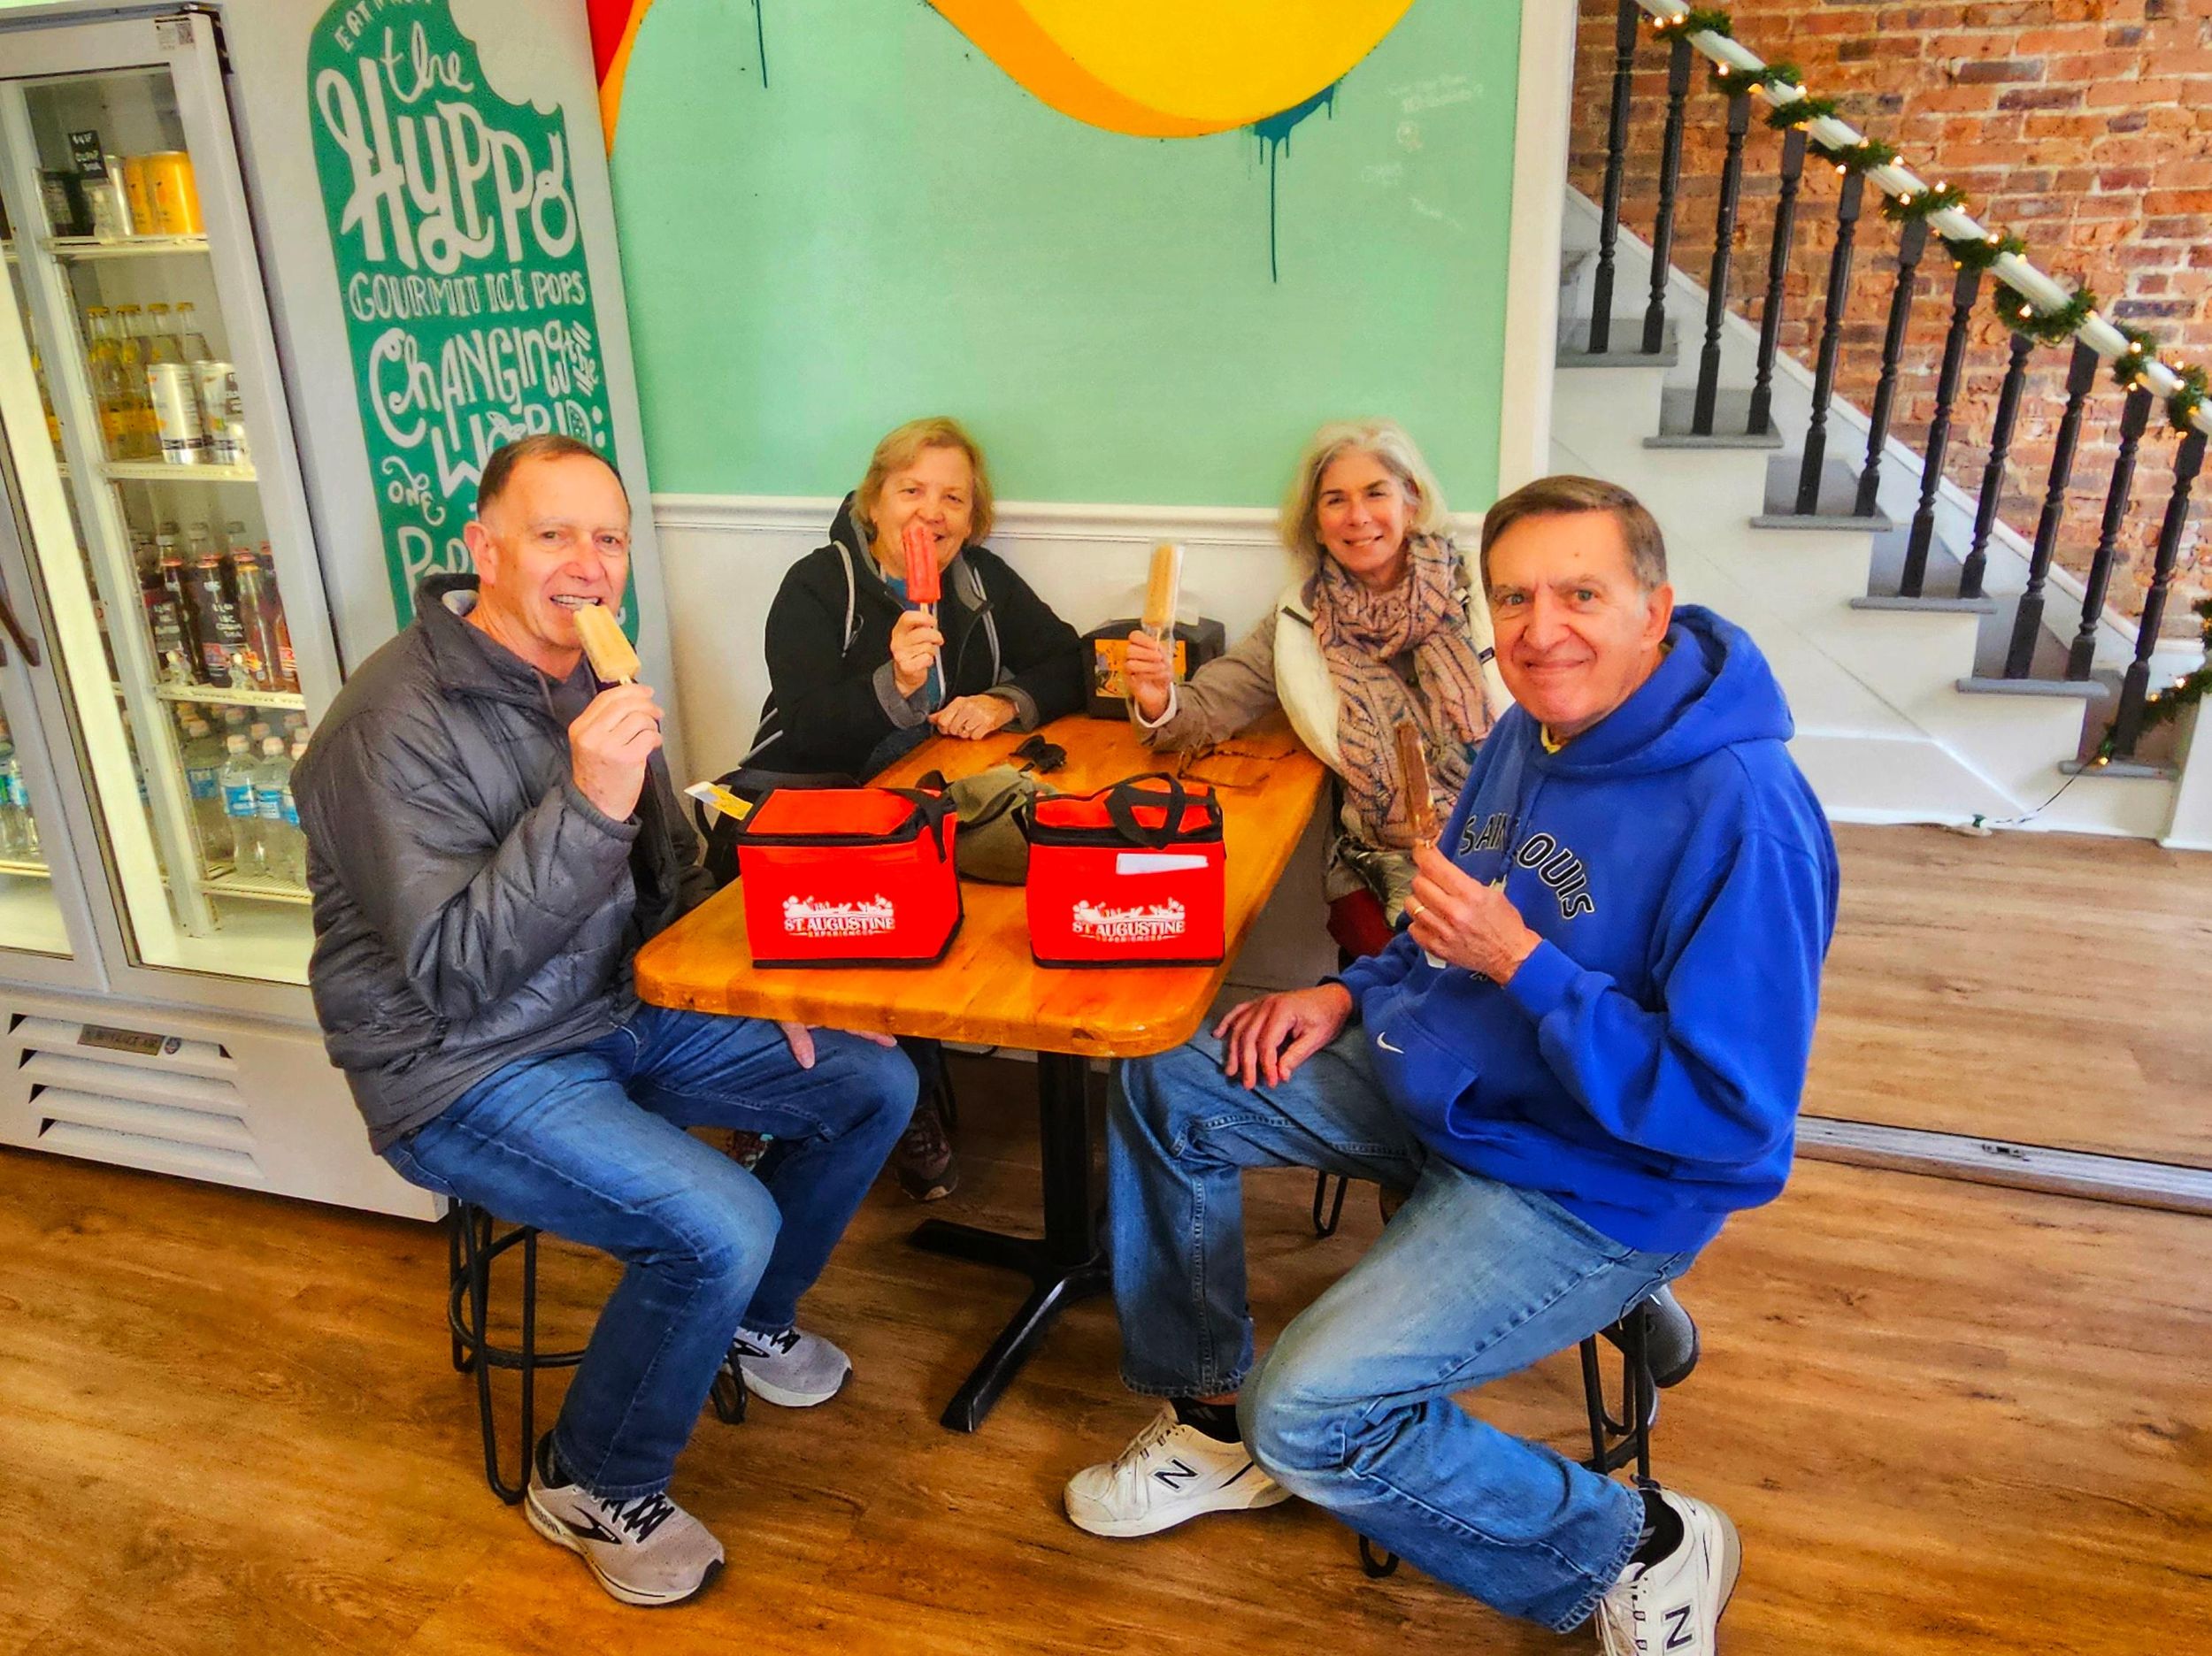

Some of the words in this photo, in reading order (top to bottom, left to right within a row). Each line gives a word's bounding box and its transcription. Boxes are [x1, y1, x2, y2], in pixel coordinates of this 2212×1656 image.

[334, 0, 373, 52] EAT
[379, 20, 474, 104] the
[348, 272, 481, 323] GOURMET
[484, 268, 530, 313] ICE
[531, 271, 586, 310] POPS
[1458, 812, 1520, 857] SAIN
[1515, 832, 1594, 919] OUIS
[807, 916, 895, 931] AUGUSTINE
[1094, 920, 1186, 937] AUGUSTINE
